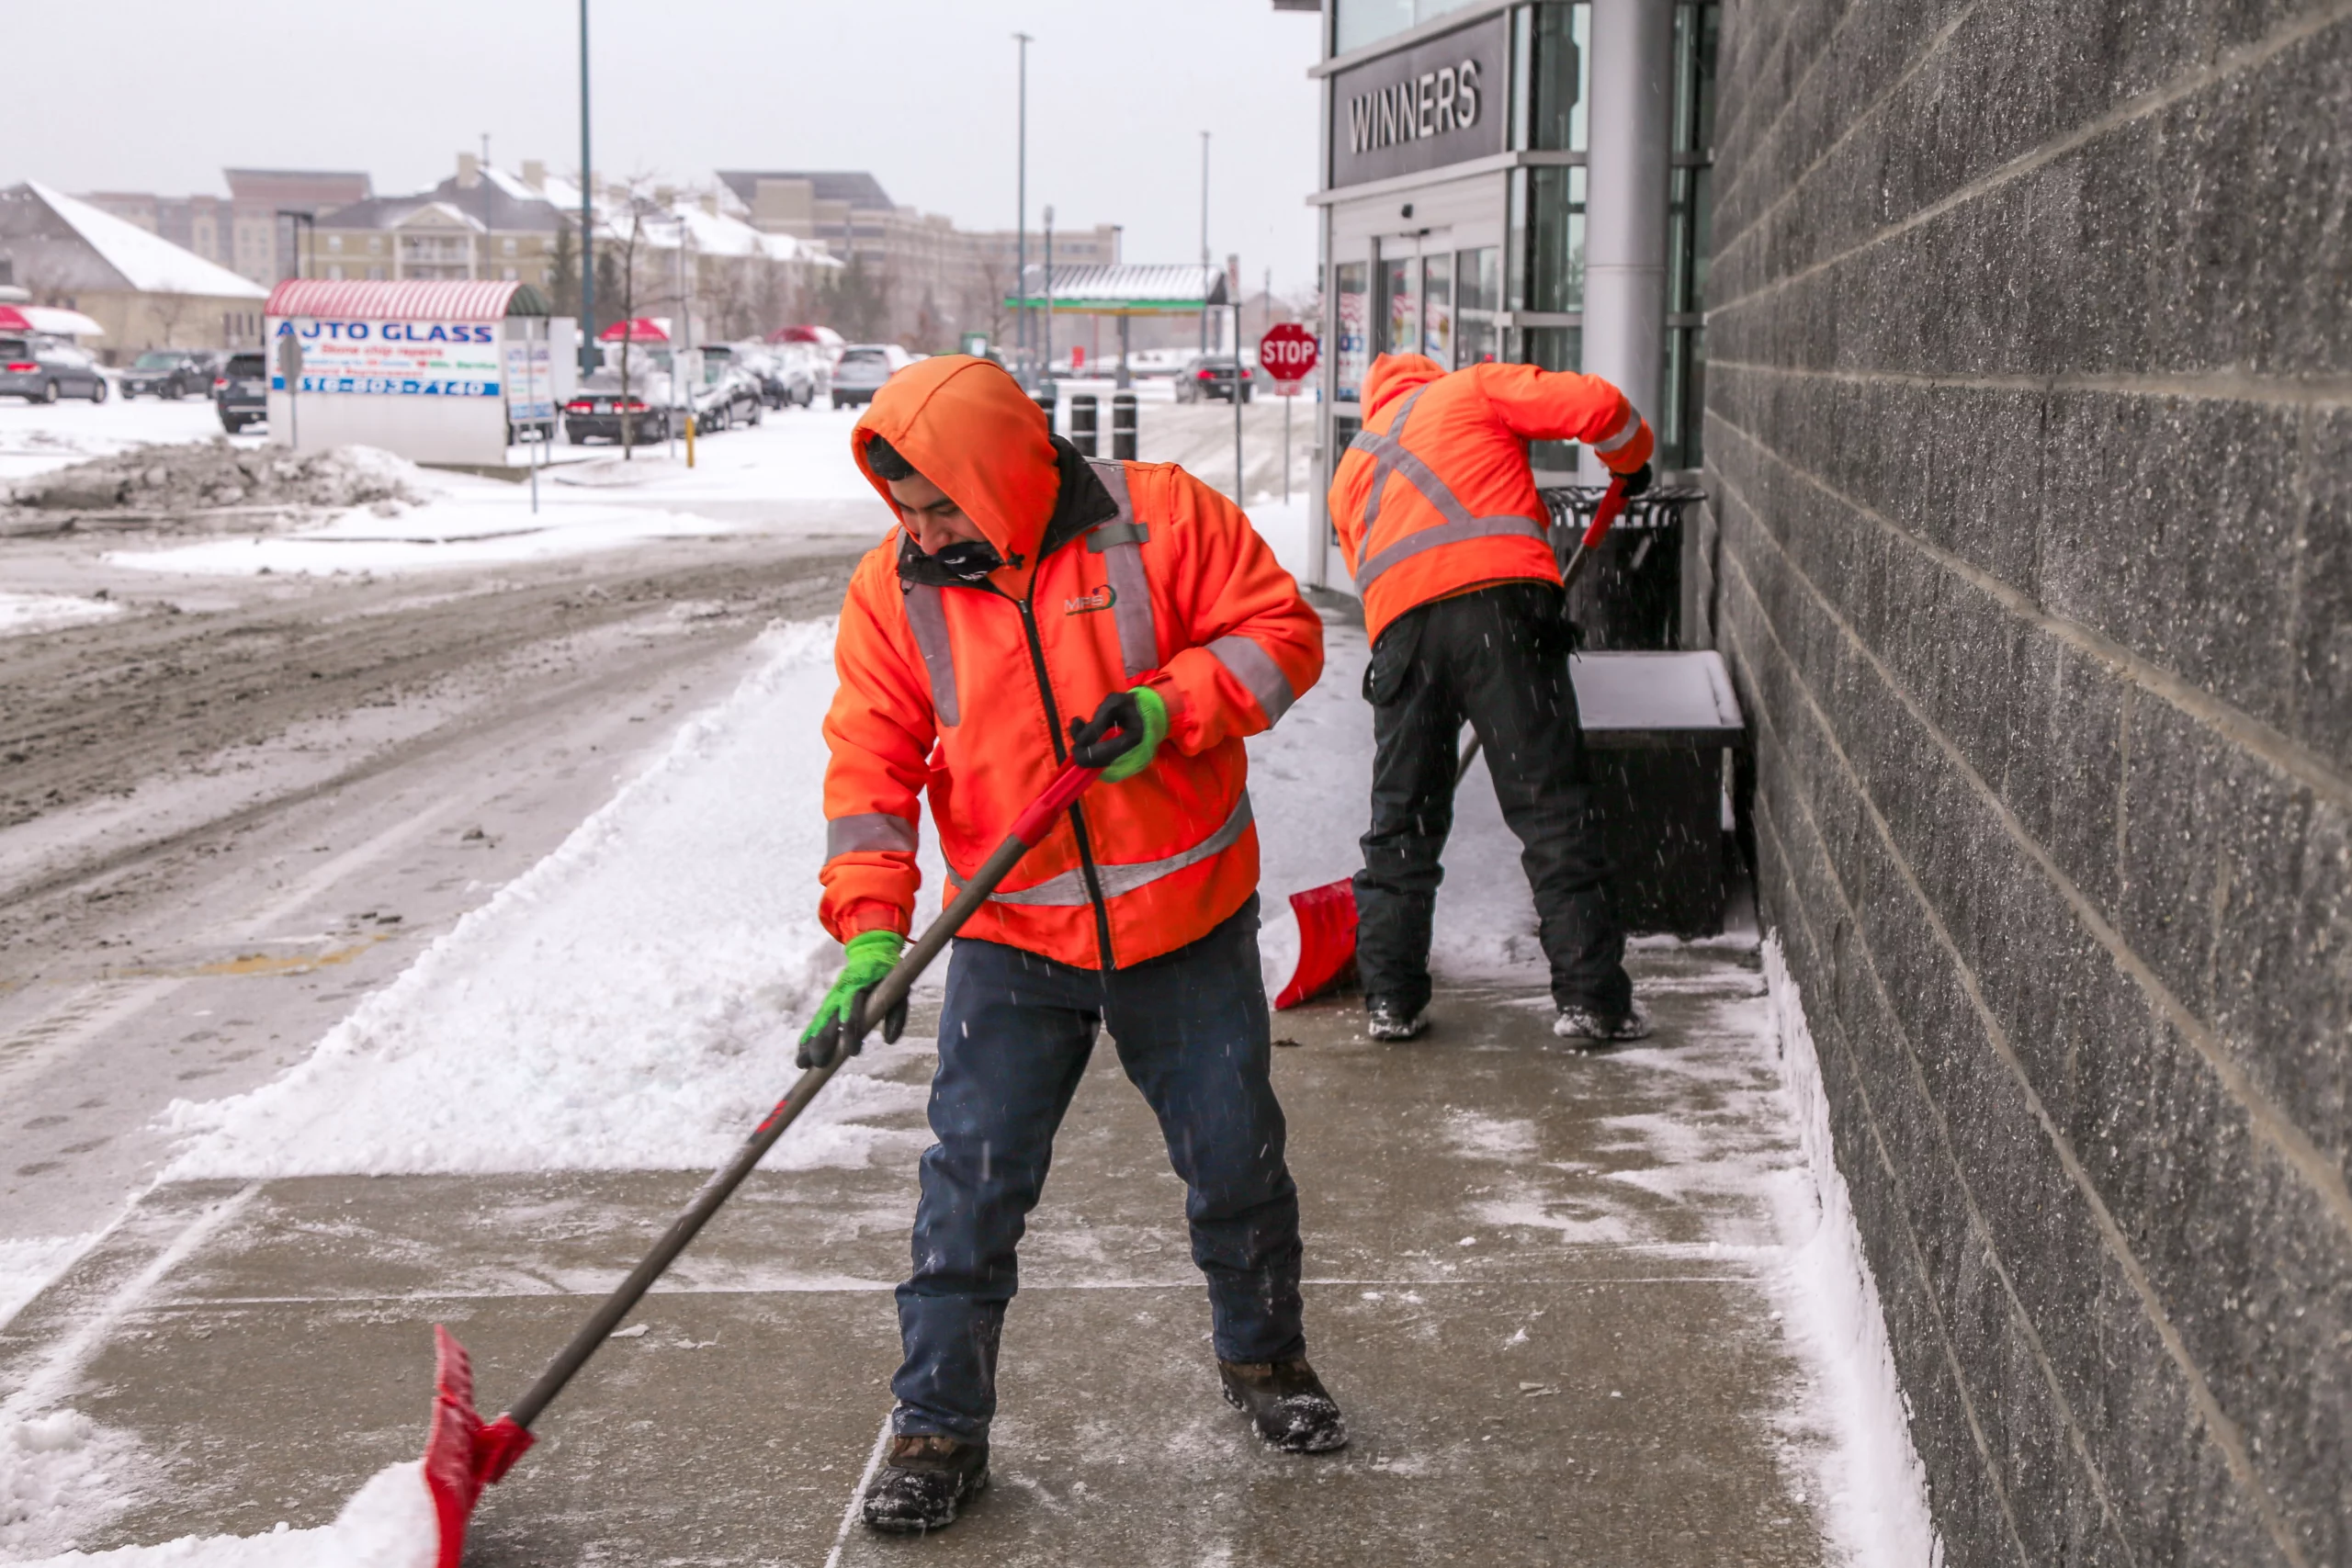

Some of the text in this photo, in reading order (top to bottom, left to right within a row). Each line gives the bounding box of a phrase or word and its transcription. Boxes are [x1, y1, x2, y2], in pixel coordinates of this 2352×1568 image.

[1348, 59, 1480, 154] WINNERS
[381, 323, 493, 343] GLASS
[1262, 340, 1316, 365] STOP
